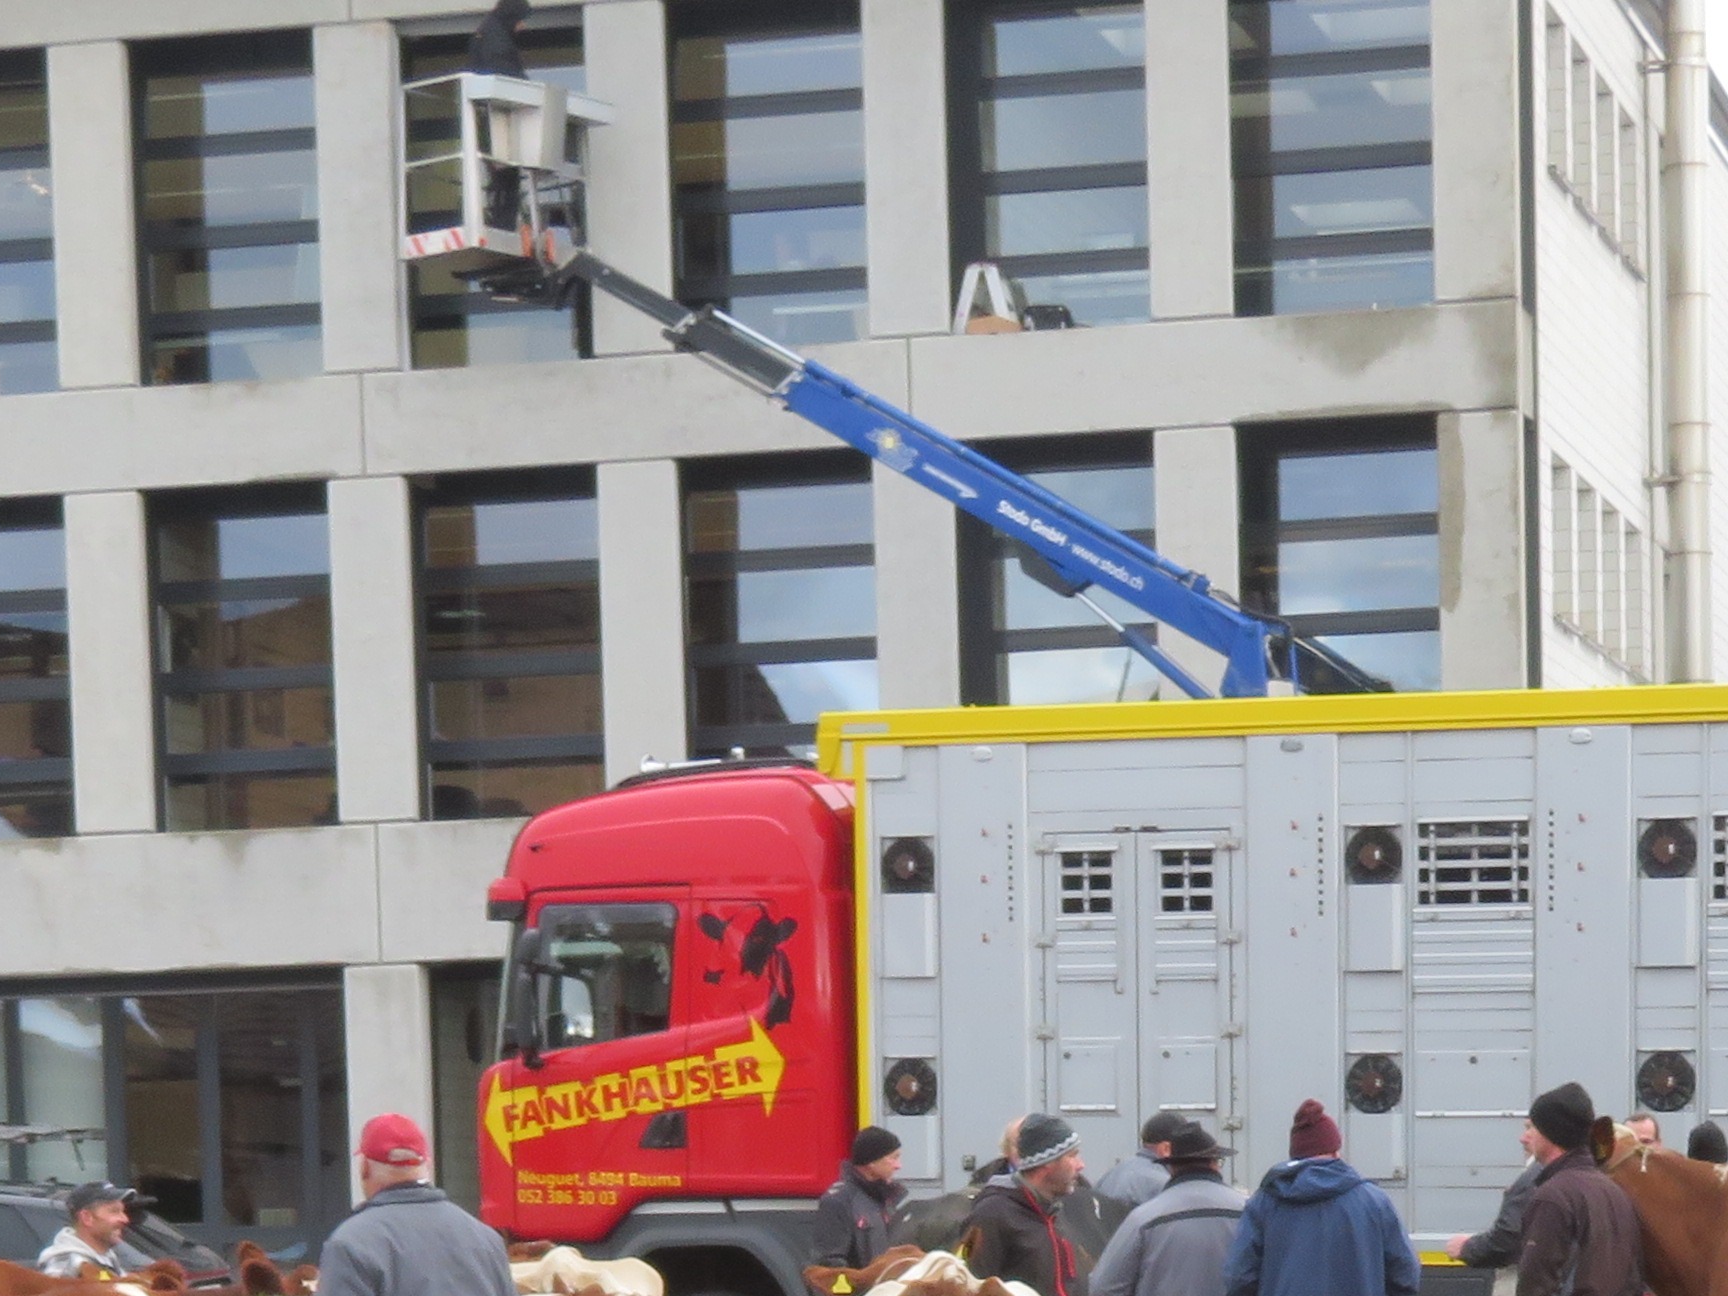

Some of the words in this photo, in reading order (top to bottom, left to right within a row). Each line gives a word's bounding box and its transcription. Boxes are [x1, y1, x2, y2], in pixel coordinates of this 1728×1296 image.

[501, 1055, 764, 1133] FANKHAUSER
[629, 1172, 682, 1188] Bauma
[516, 1188, 543, 1204] 052
[578, 1190, 595, 1206] 30
[599, 1190, 618, 1206] 03
